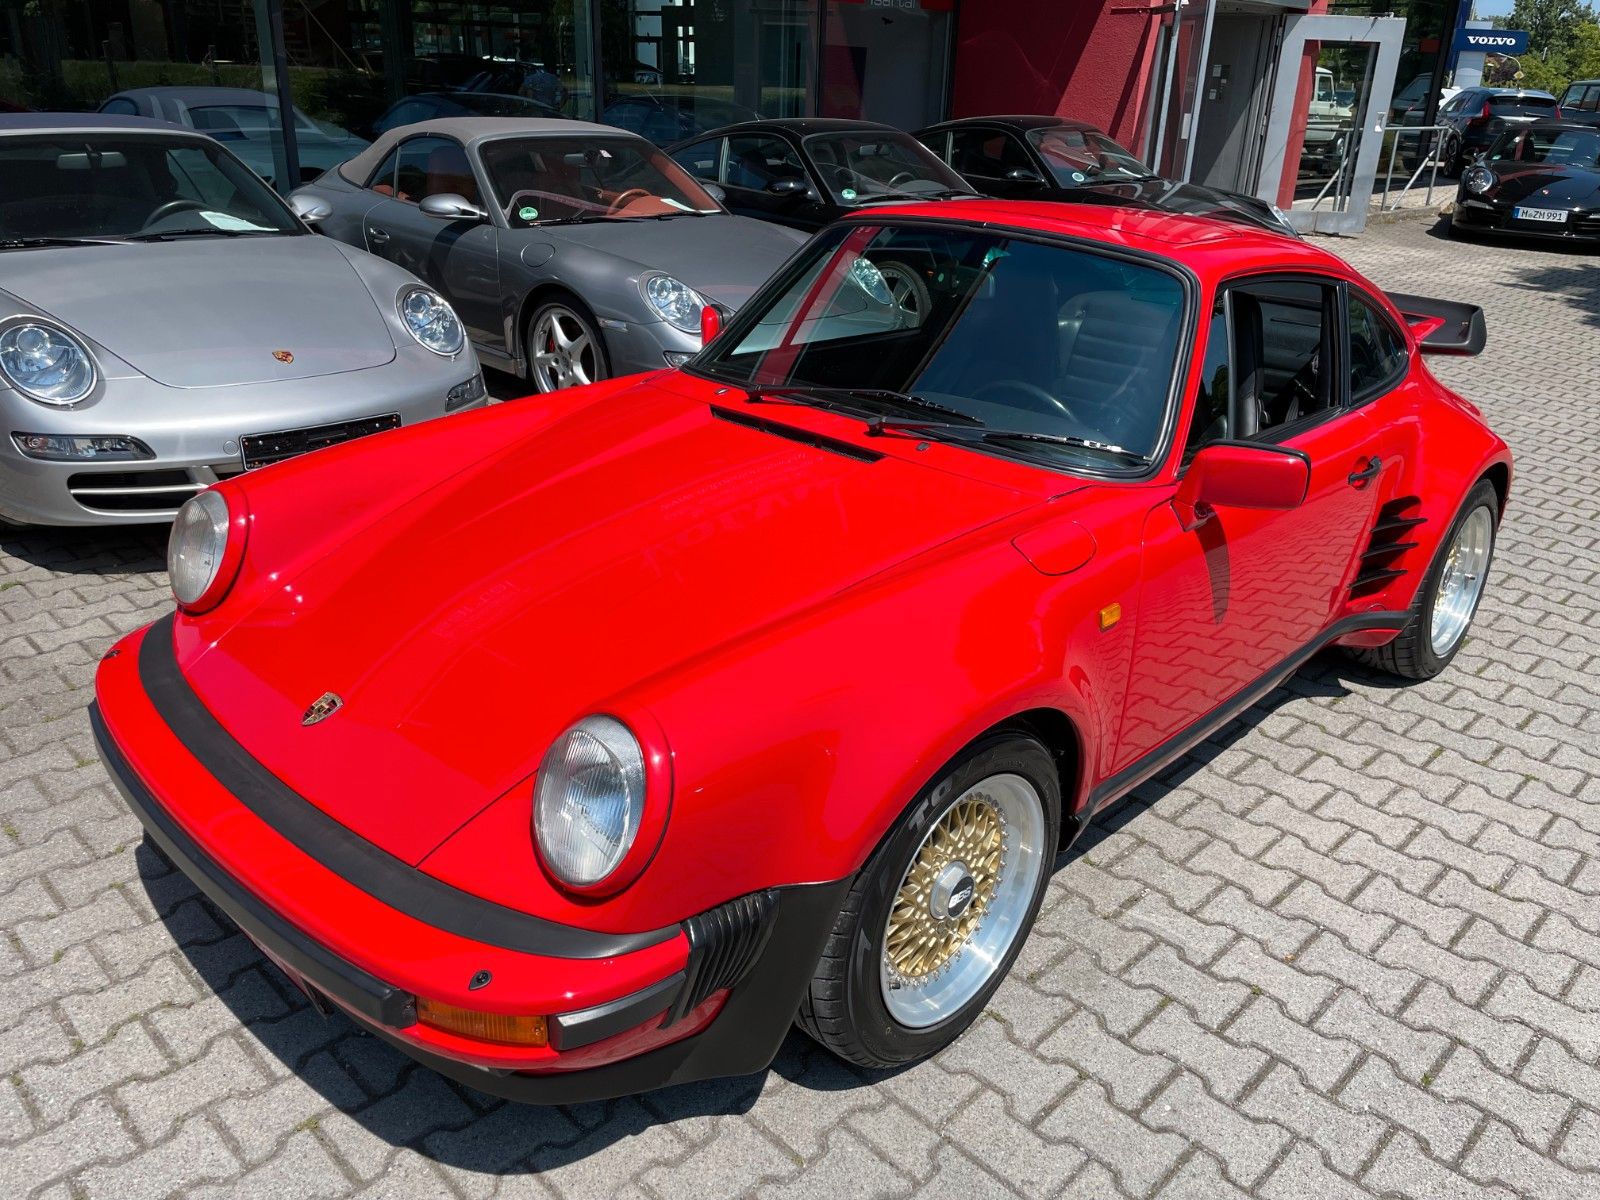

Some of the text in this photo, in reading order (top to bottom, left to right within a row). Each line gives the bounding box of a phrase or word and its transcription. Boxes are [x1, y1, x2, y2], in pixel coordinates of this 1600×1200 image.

[1467, 35, 1516, 46] VOLVO
[1546, 211, 1562, 221] 991
[948, 885, 972, 909] BBS
